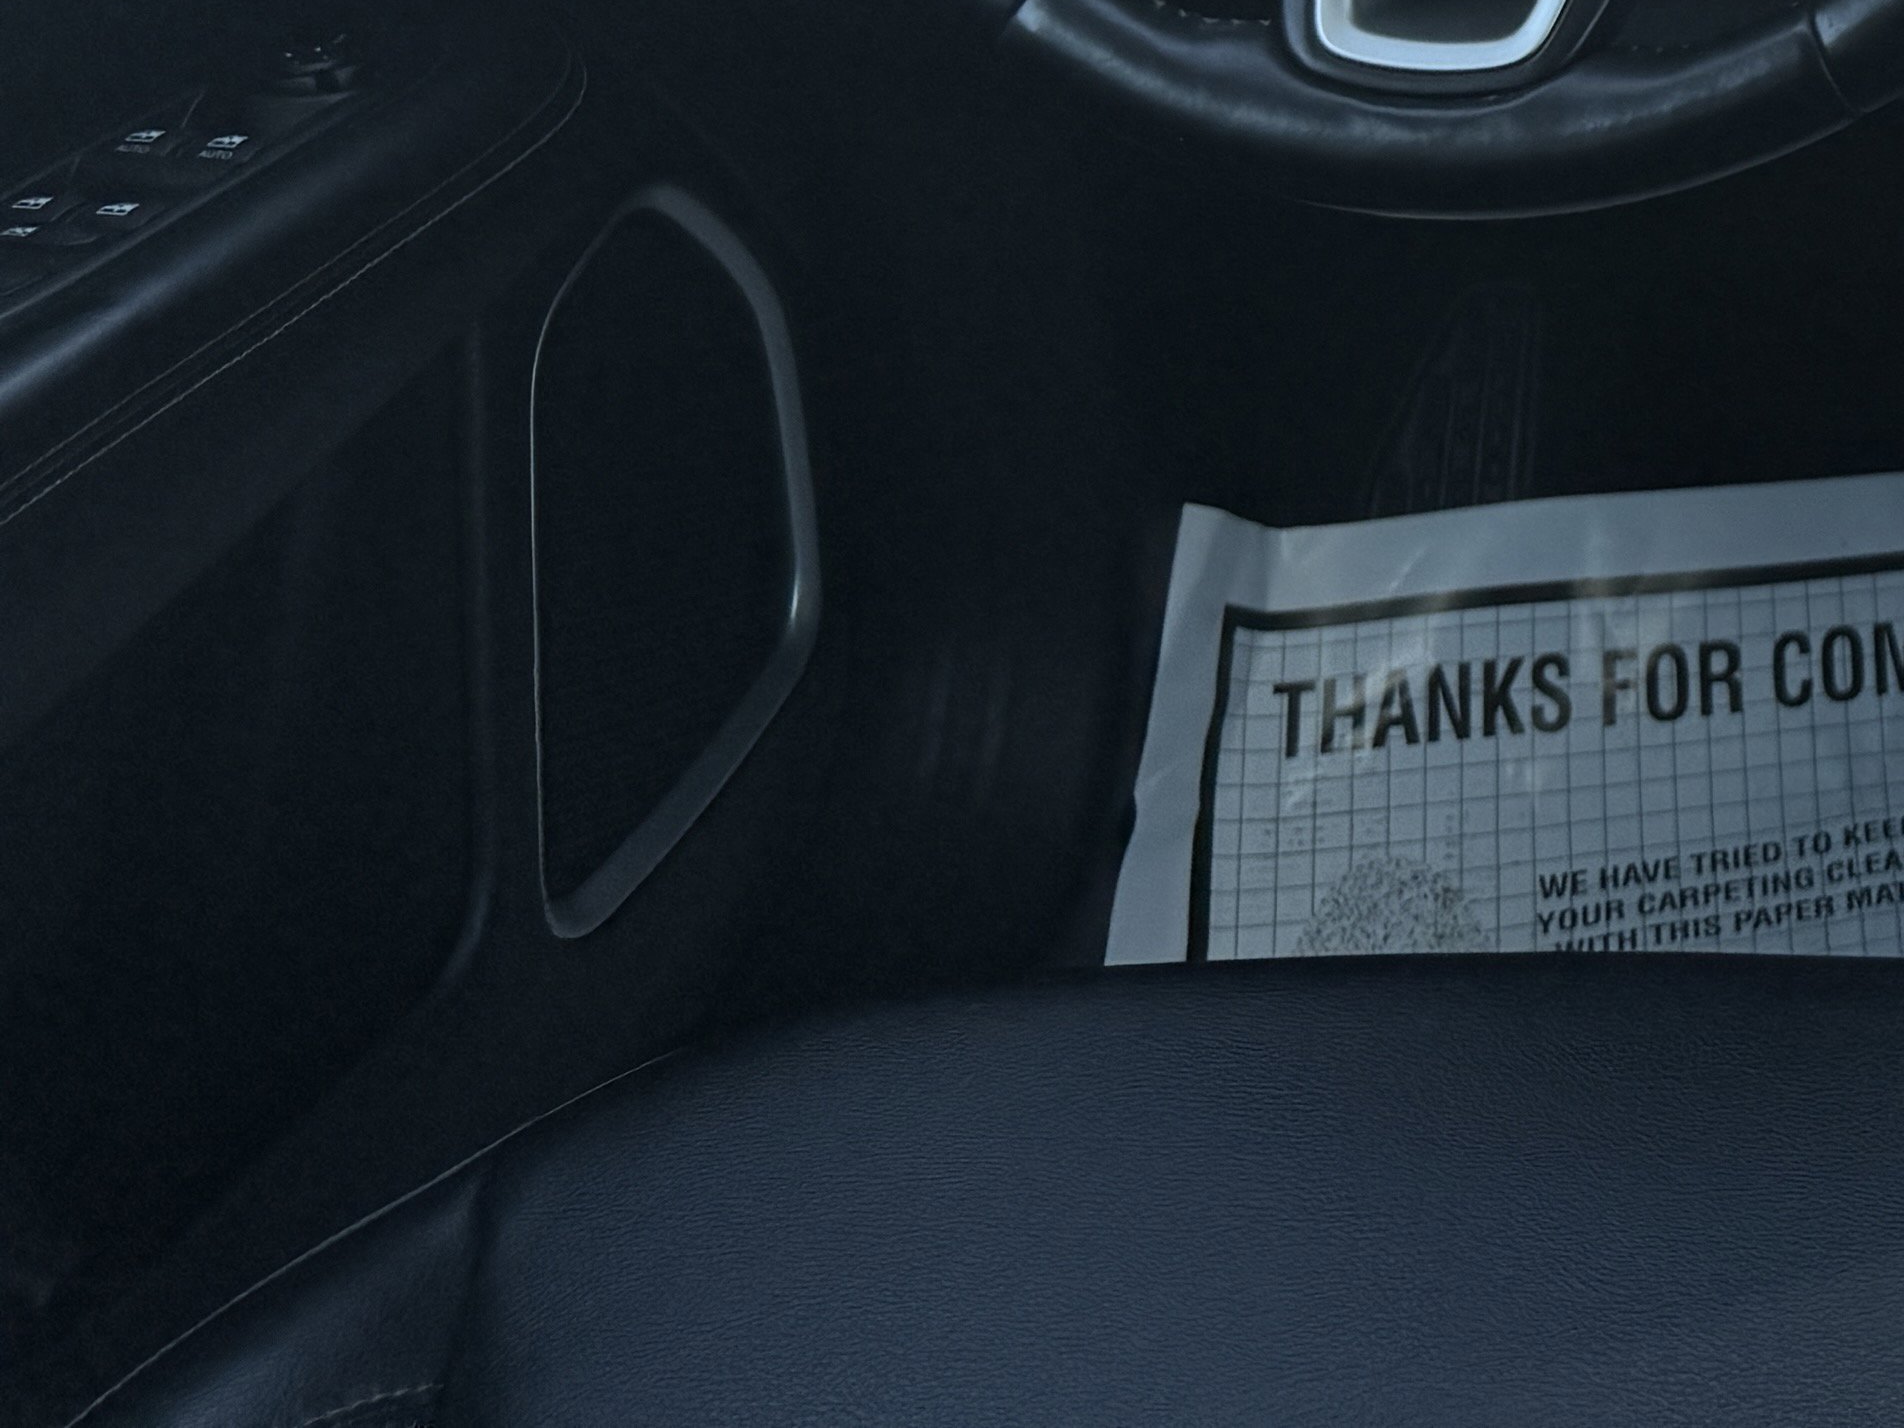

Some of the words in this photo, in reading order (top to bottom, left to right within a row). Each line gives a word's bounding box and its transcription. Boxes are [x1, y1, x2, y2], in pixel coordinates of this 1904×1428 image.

[1272, 652, 1574, 760] THANKS
[1599, 636, 1746, 729] FOR
[1538, 870, 1591, 901] WE
[1600, 858, 1679, 894] HAVE
[1681, 844, 1783, 884] TRIED
[1794, 834, 1834, 864] TO
[1538, 901, 1628, 938] YOUR
[1636, 870, 1816, 926] CARPETING
[1646, 913, 1724, 948] THIS
[1732, 894, 1837, 936] PAPER
